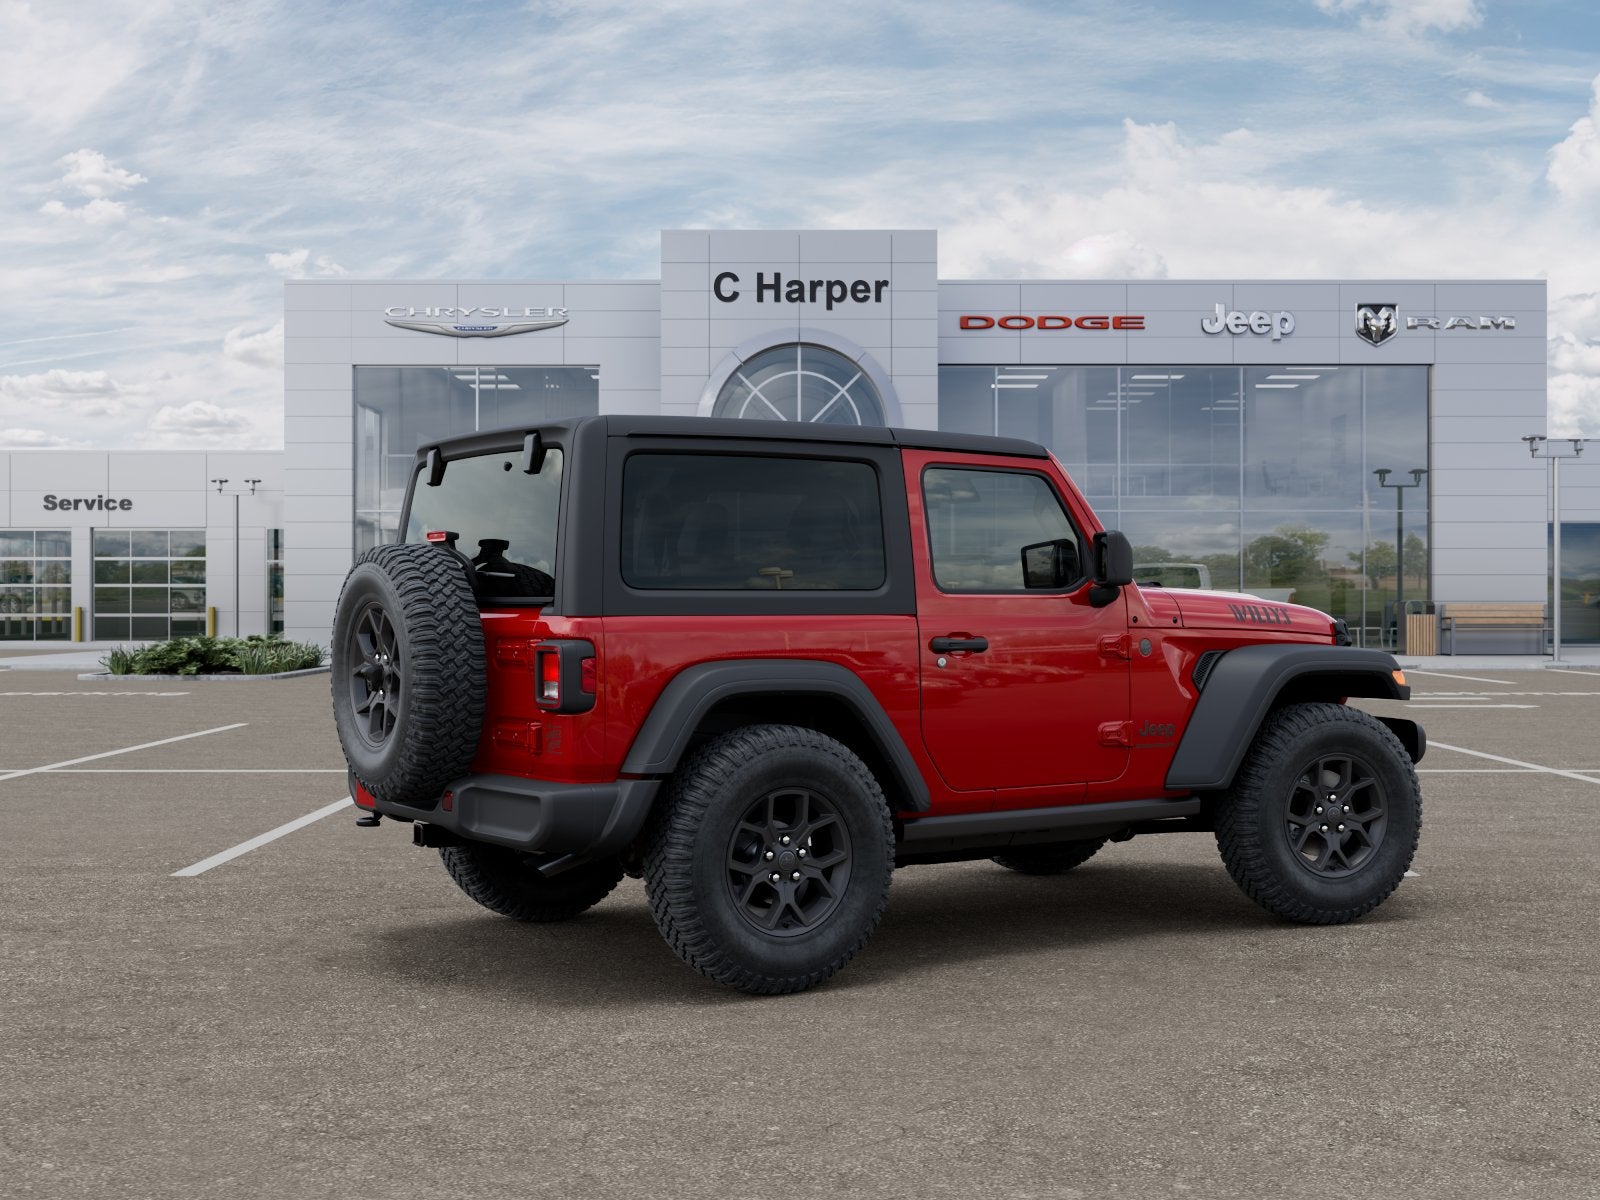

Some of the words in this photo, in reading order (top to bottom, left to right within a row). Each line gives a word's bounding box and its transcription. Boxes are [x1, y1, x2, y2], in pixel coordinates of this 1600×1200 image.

[712, 271, 741, 304] C
[756, 271, 890, 311] Harper
[384, 305, 569, 318] CHRYSLER
[959, 315, 1146, 331] DODGE
[1201, 303, 1295, 342] Jeep
[1406, 315, 1516, 331] RAM
[43, 494, 133, 511] Service
[1228, 604, 1292, 625] WILLYS
[1139, 719, 1175, 739] Jeep
